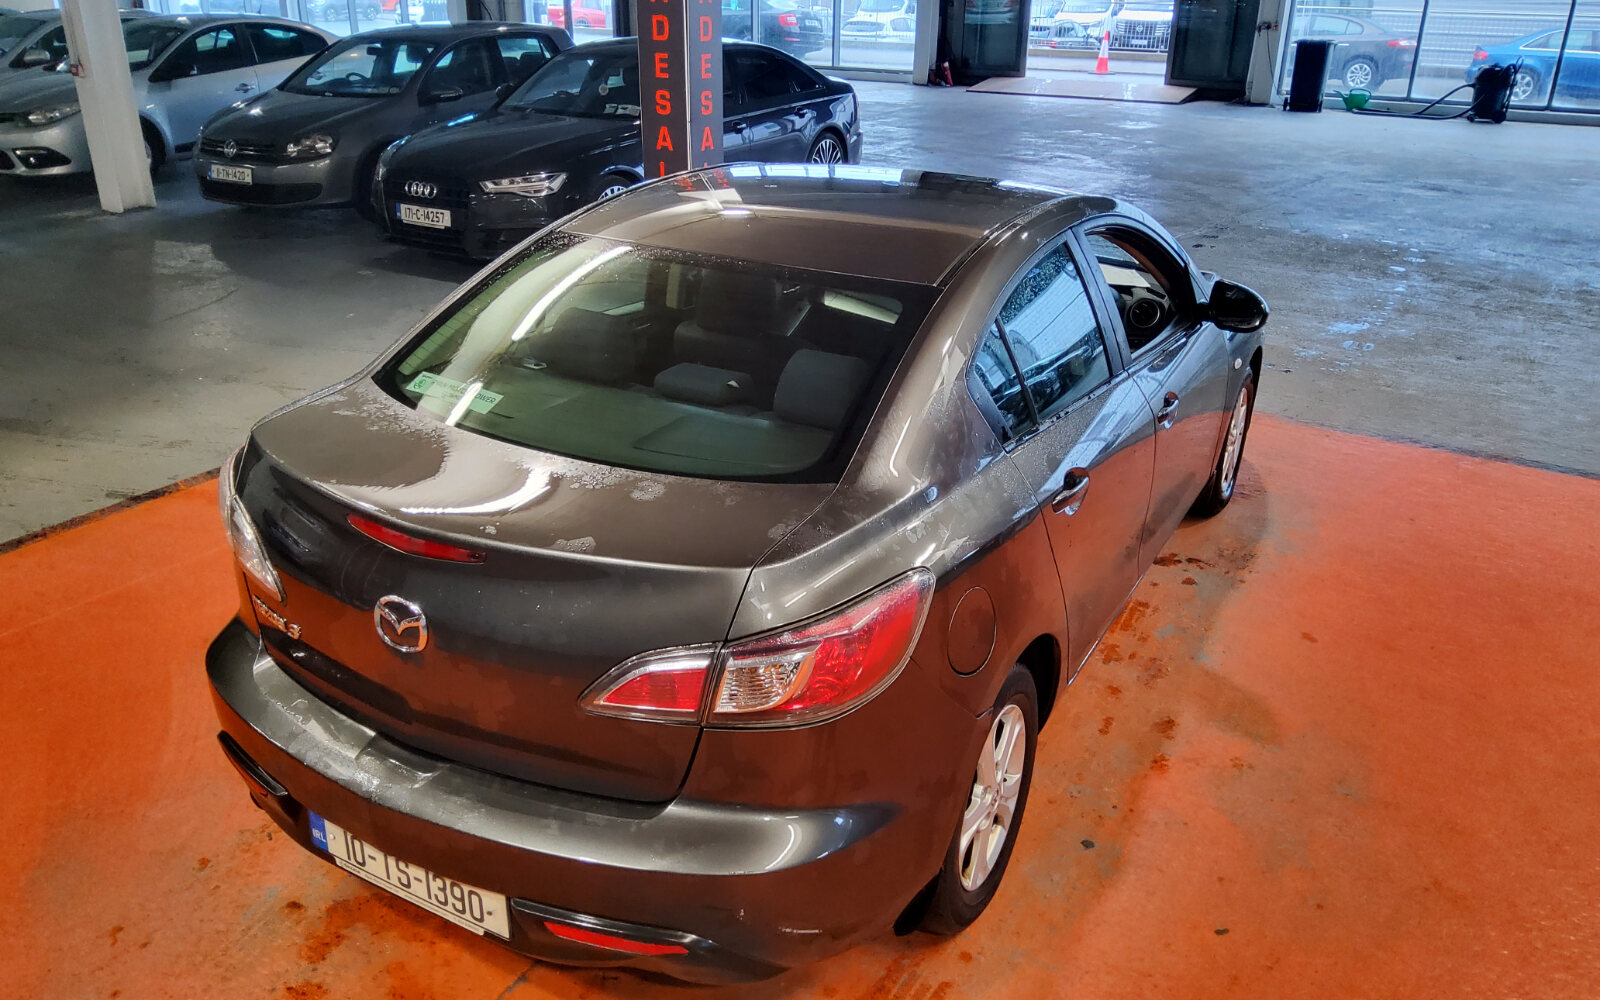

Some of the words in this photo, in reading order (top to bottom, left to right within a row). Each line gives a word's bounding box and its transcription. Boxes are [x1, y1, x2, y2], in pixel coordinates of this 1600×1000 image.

[652, 0, 673, 178] DESA
[699, 0, 714, 167] DESA
[404, 207, 445, 224] 171-C-14257
[311, 828, 326, 842] IRL
